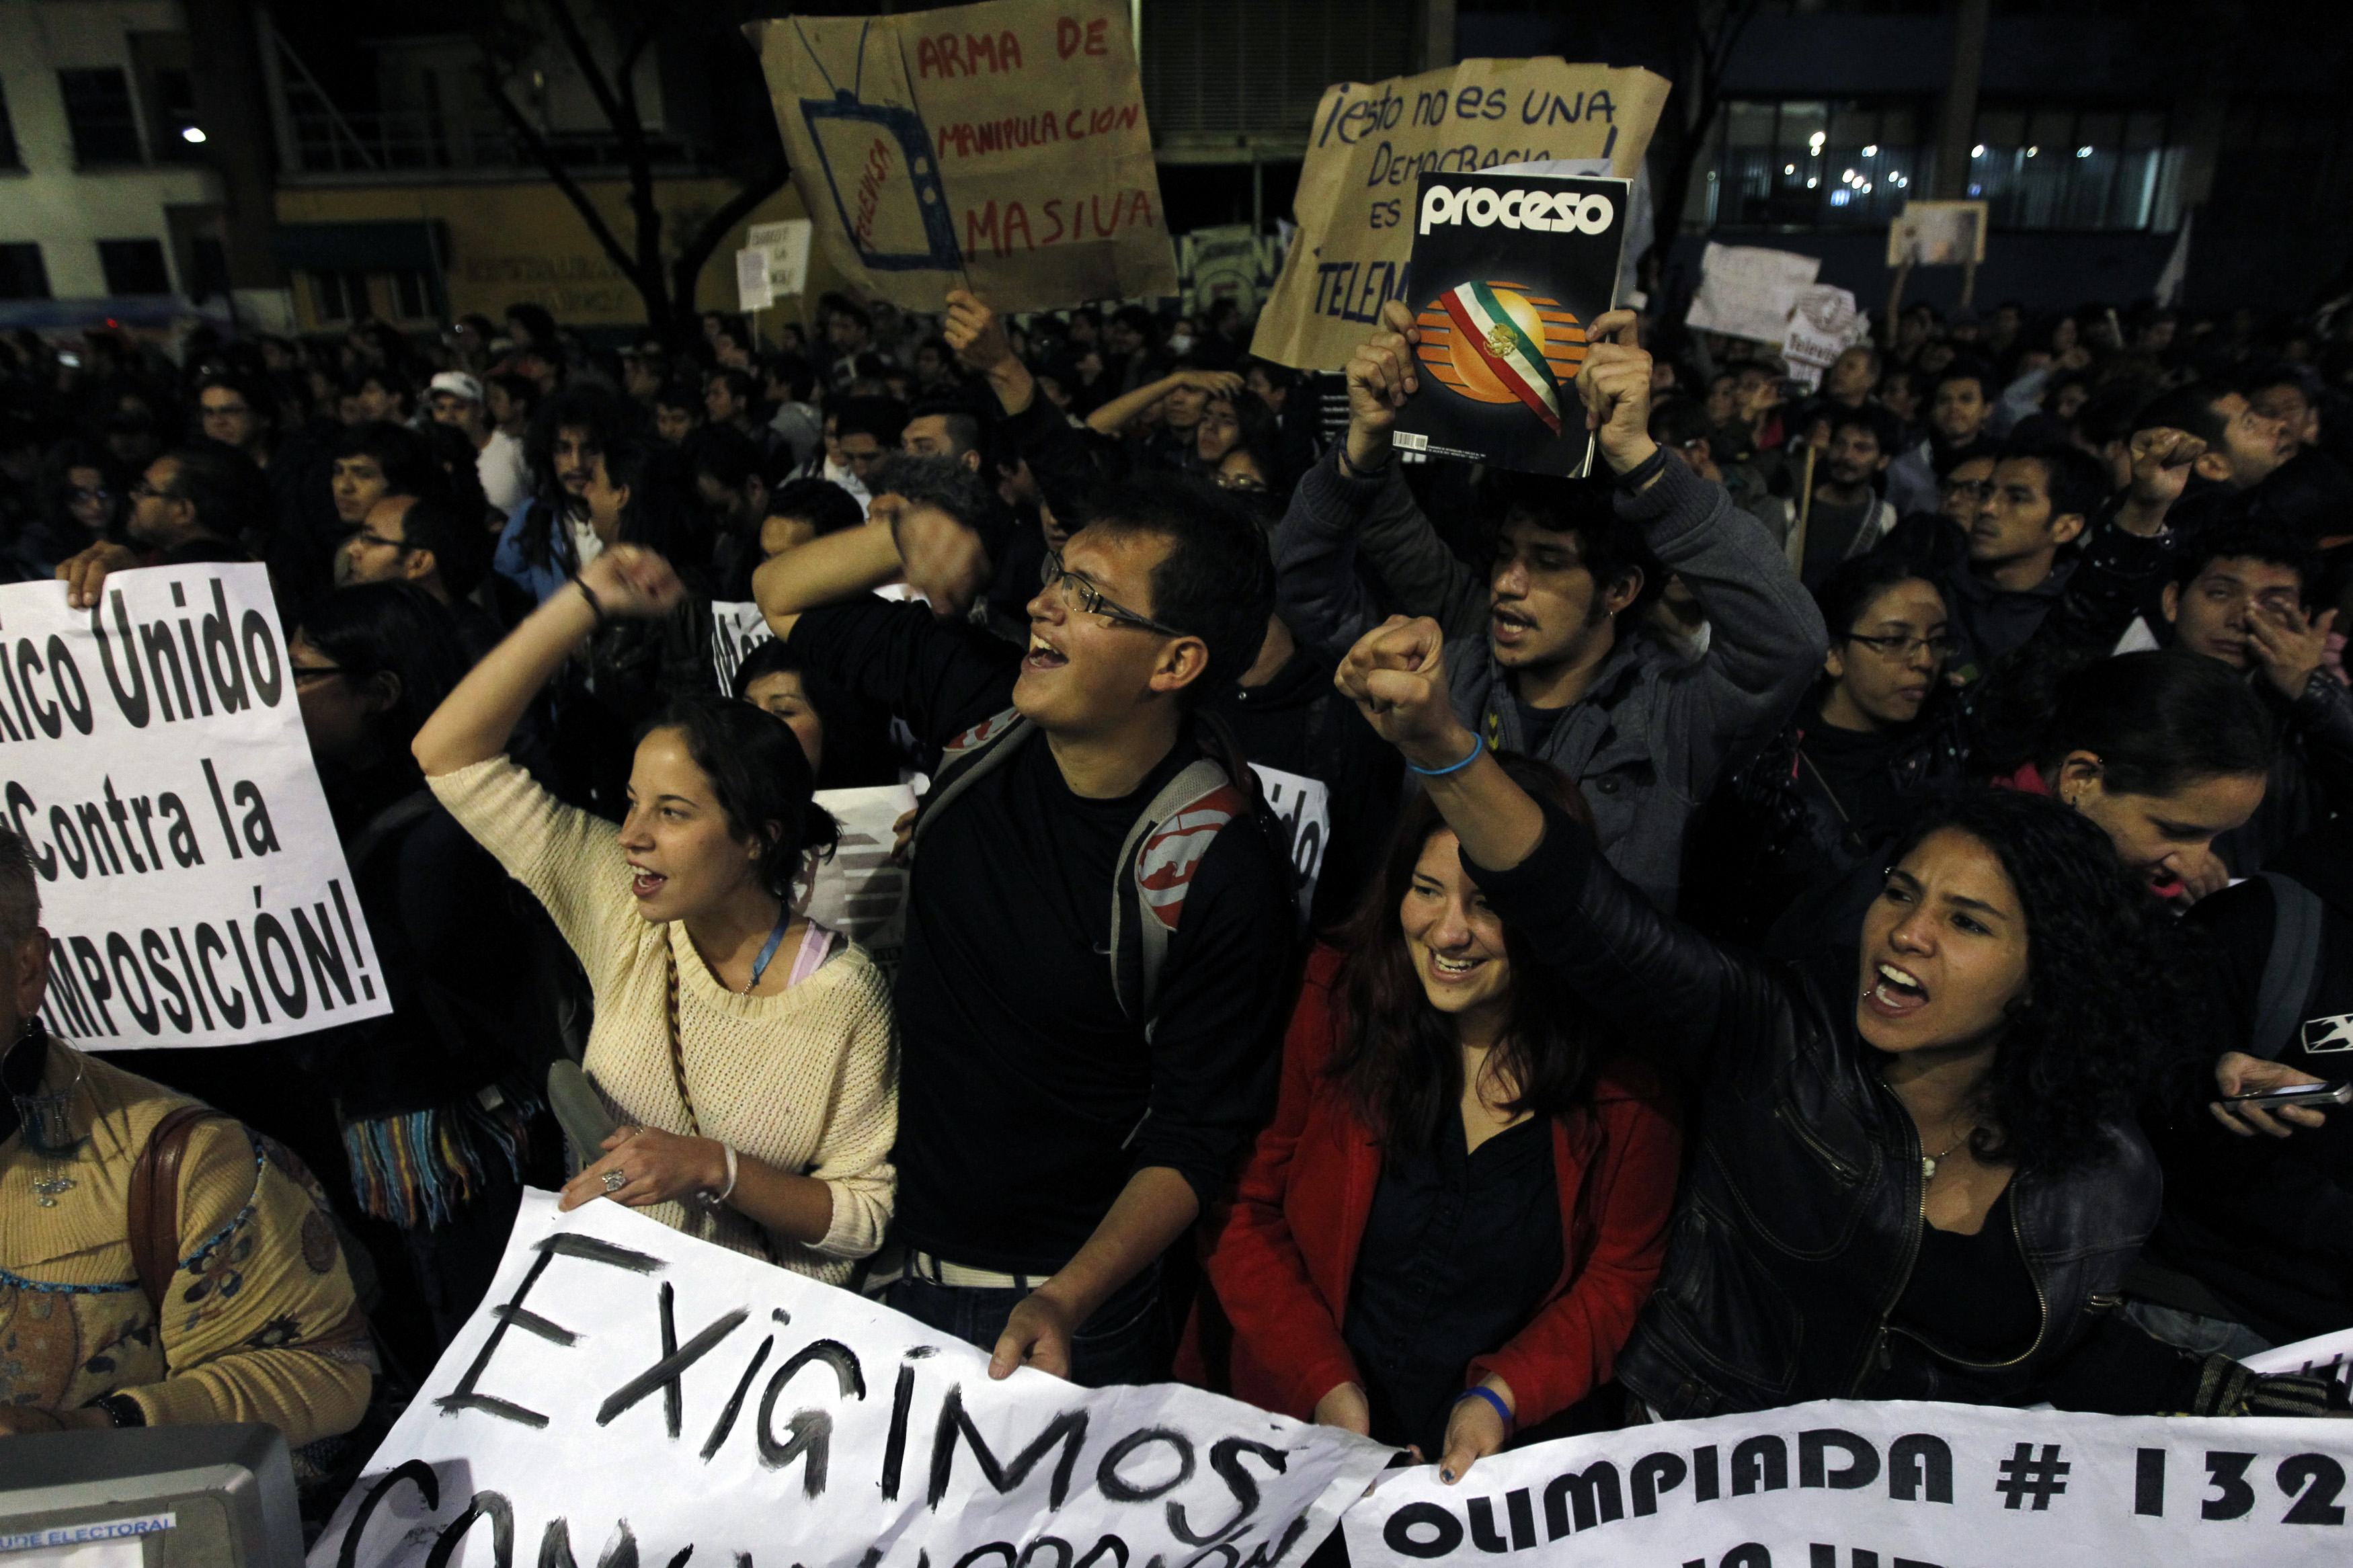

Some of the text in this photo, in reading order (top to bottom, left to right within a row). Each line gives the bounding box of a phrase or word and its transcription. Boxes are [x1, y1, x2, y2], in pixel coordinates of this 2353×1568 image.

[917, 16, 1108, 79] ARMA DE
[938, 103, 1139, 158] MANIPULACION
[1412, 89, 1447, 126] no
[1521, 90, 1616, 125] UNA
[1419, 185, 1614, 235] proceso
[0, 577, 283, 743] ico Unido
[200, 758, 281, 859] la
[1383, 1428, 1953, 1559] OLIMPIADA
[1995, 1442, 2071, 1511] #
[48, 1518, 175, 1546] ELECTORAL
